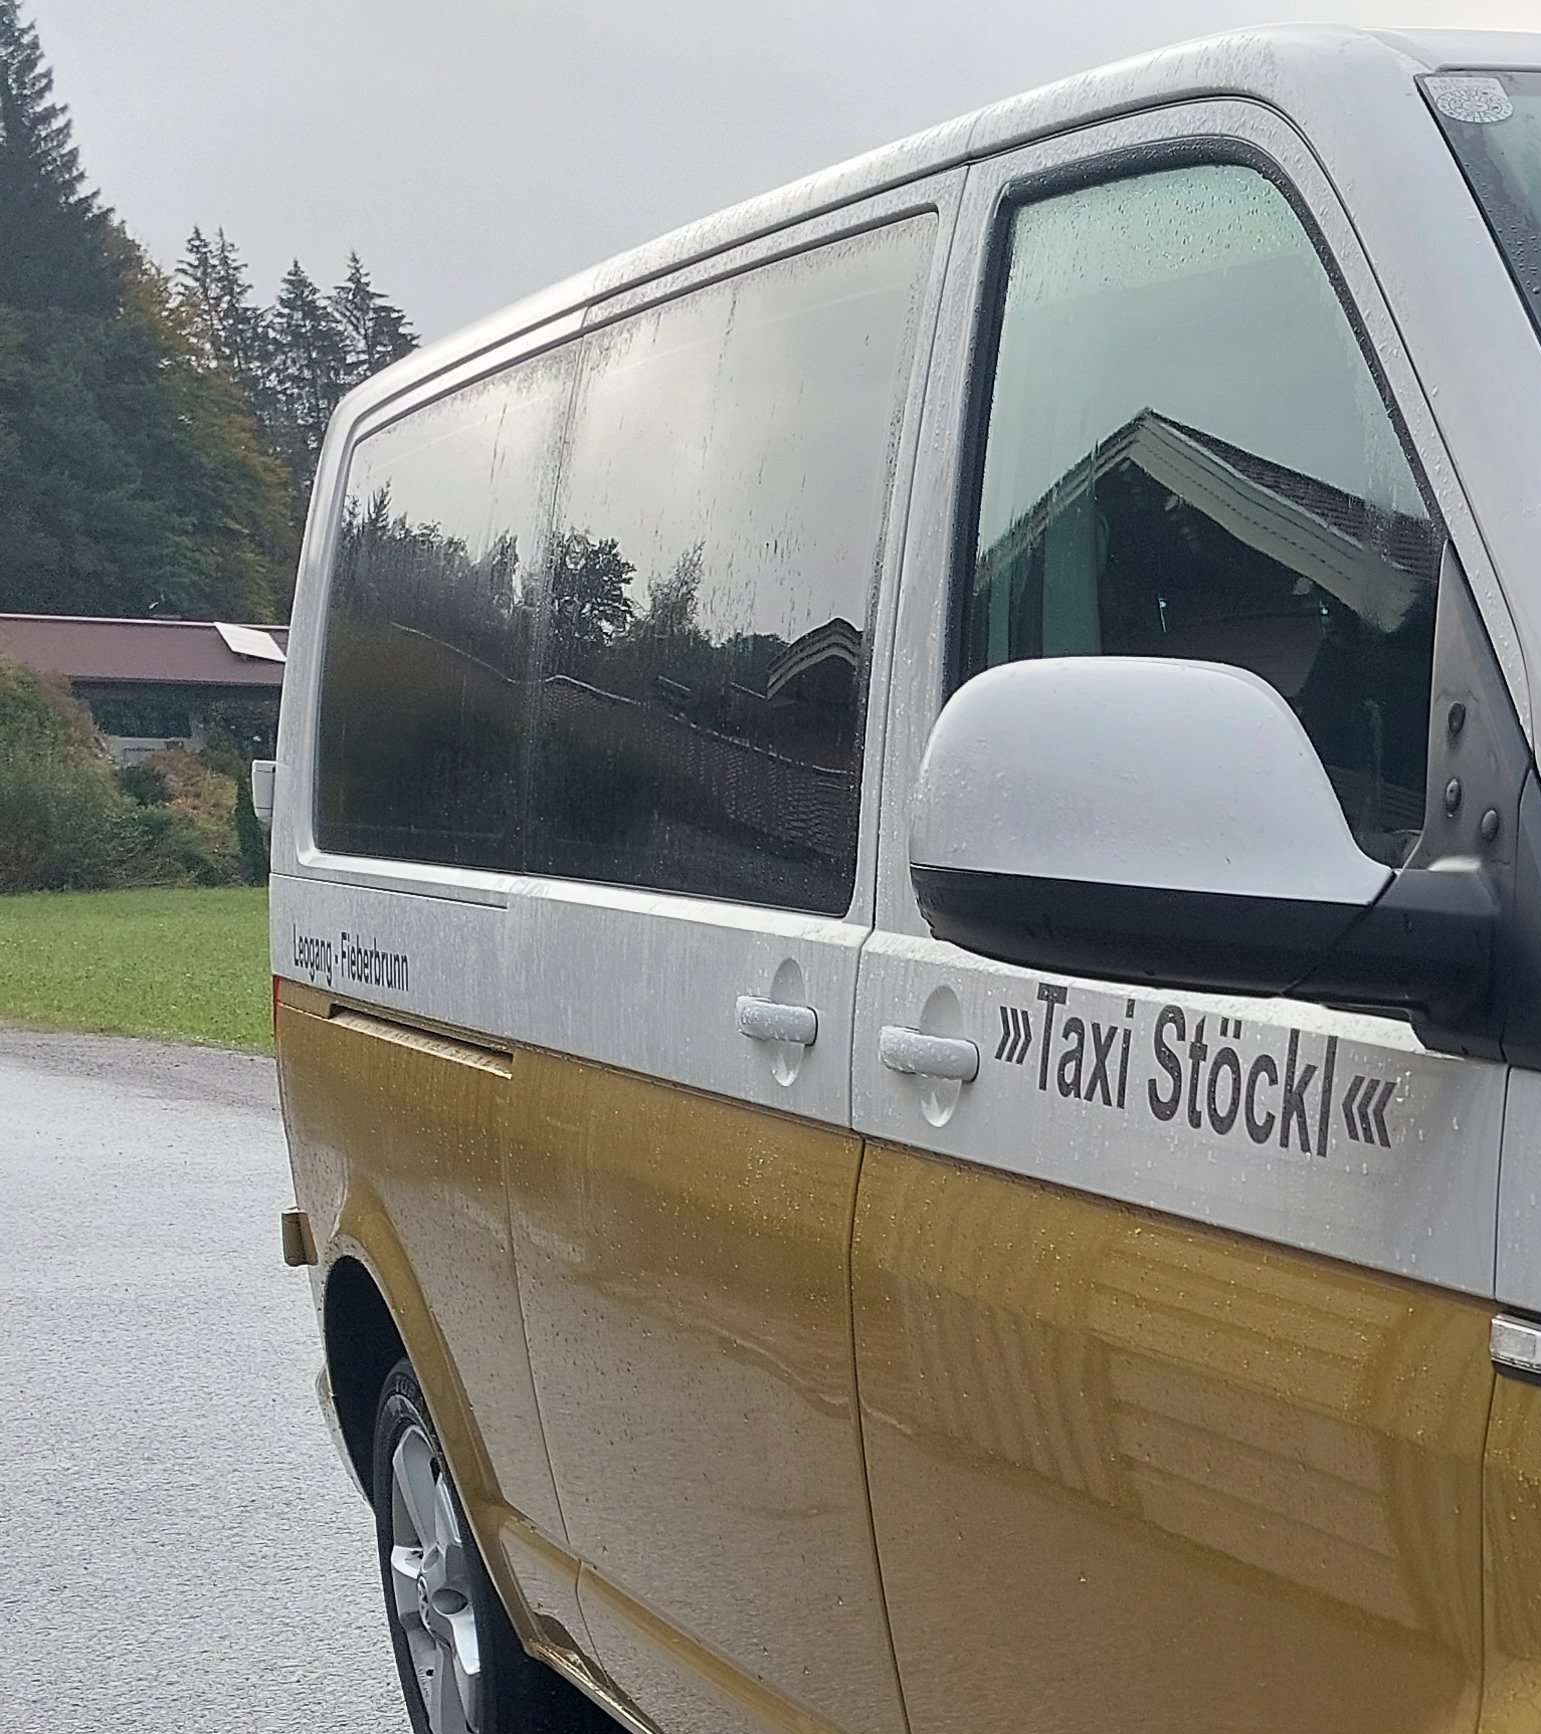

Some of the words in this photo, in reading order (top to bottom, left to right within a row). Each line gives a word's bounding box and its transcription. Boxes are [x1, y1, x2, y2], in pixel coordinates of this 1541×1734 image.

[292, 923, 332, 987] Leogang
[341, 931, 409, 991] Fieberbrunn
[1037, 982, 1133, 1109] Taxi
[1148, 1005, 1338, 1158] Stöckl
